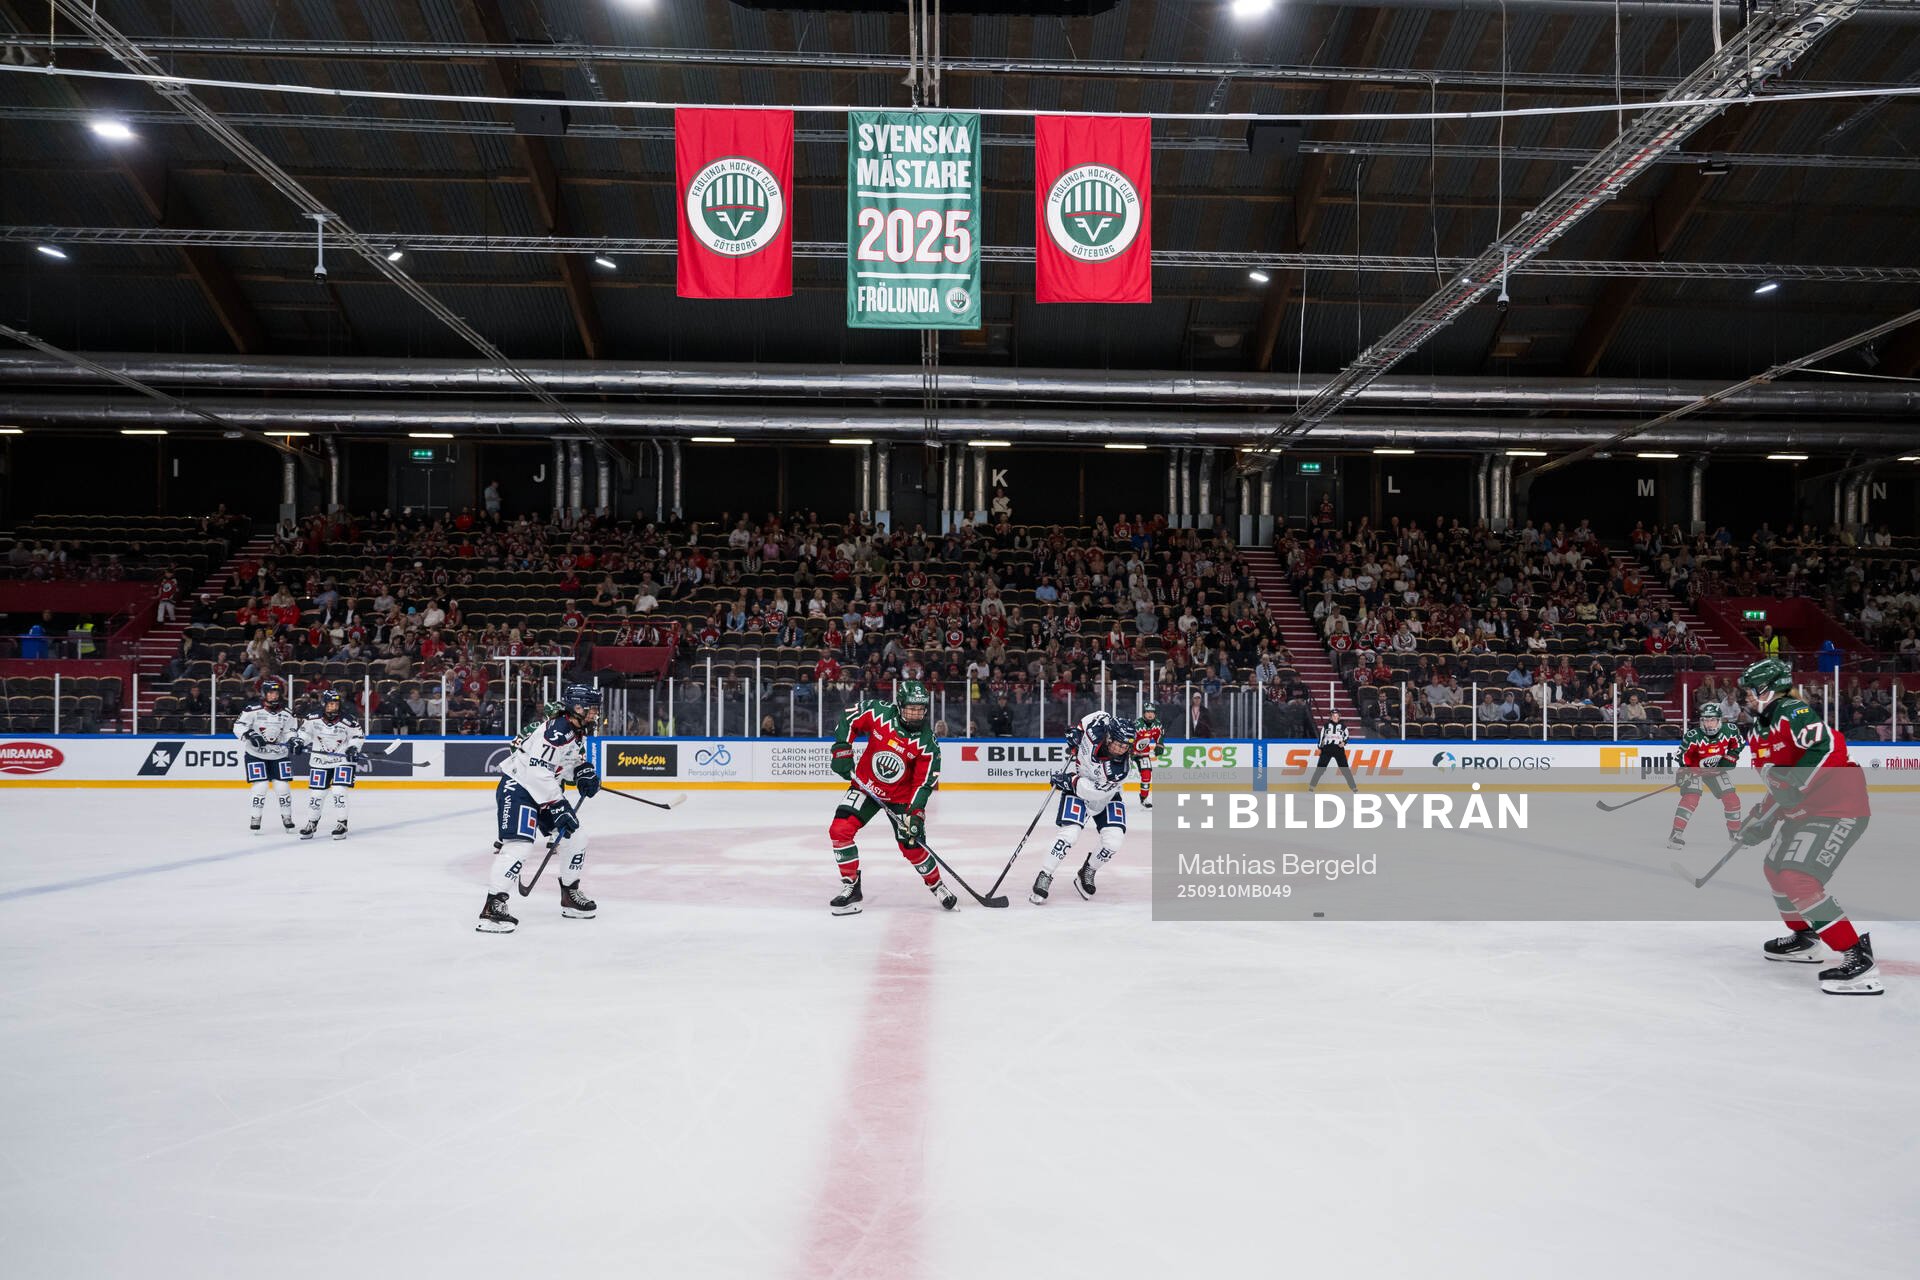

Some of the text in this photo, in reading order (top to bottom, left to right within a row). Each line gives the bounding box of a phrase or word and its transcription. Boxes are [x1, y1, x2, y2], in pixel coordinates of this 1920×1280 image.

[858, 123, 971, 153] SVENSKA
[692, 162, 778, 197] FRÖLUNDA HOCKEY CLUB
[857, 154, 971, 188] MÄSTARE
[1051, 168, 1136, 204] FRÖLUNDA HOCKEY CLUB
[857, 207, 971, 263] 2025
[713, 238, 758, 252] GÖTEBORG
[1071, 244, 1116, 258] GÖTEBORG
[857, 282, 939, 313] FRÖLUNDA
[533, 464, 545, 483] J
[992, 469, 1008, 487] K
[1388, 476, 1400, 494] L
[1637, 479, 1654, 497] M
[1872, 482, 1886, 500] N
[1797, 722, 1824, 749] 27
[185, 751, 238, 767] DFDS
[541, 744, 556, 761] 71
[618, 752, 666, 766] Sportson
[1462, 757, 1551, 771] PROLOGIS
[1886, 757, 1920, 770] FRÖLUND
[688, 769, 737, 777] Personalcyklar
[988, 768, 1013, 777] Billes
[1015, 768, 1053, 778] Tryckeri
[1183, 771, 1237, 779] CLEAN FUELS
